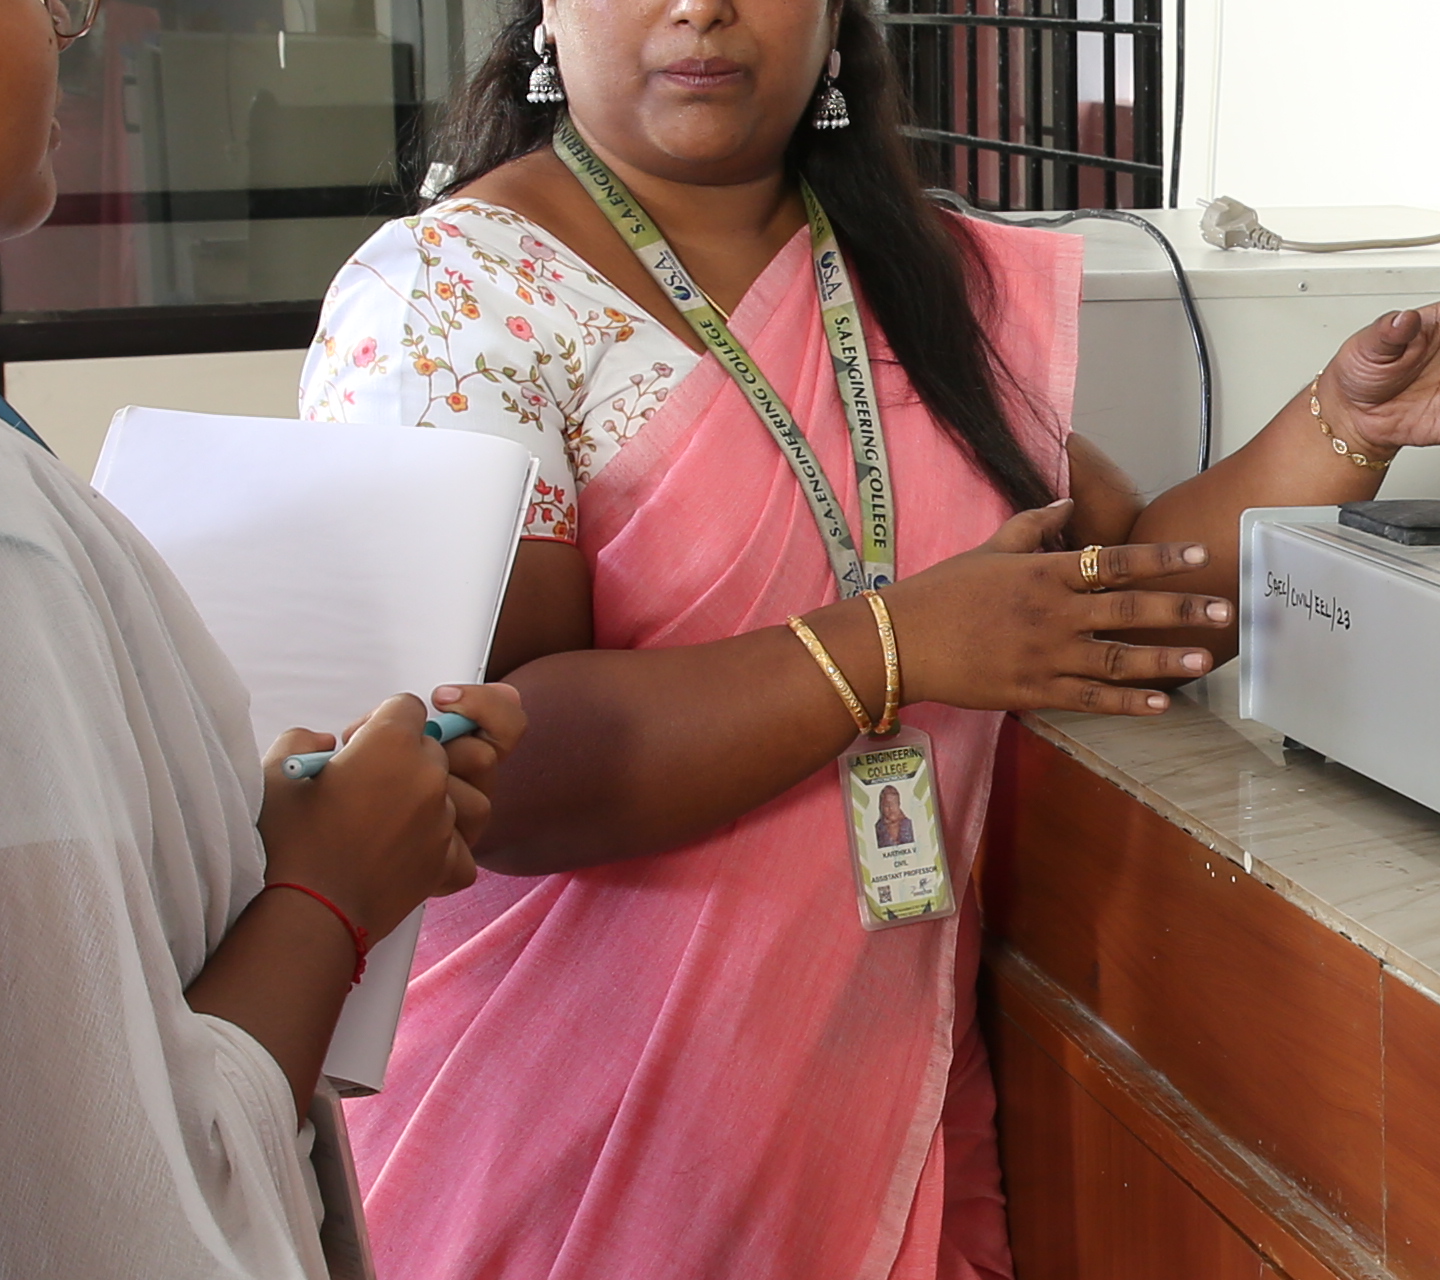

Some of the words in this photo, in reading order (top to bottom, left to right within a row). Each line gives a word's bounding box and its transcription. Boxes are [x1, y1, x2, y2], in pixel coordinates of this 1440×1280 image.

[654, 251, 683, 286] S.A.
[824, 265, 842, 300] S.A.
[700, 319, 756, 384] COLLEGE
[834, 316, 879, 461] S.A.ENGINEERING
[868, 466, 887, 548] COLLEGE
[753, 388, 842, 538] S.A.ENGINEERING
[866, 761, 909, 778] COLLEGE
[870, 871, 902, 883] ASSISTANT
[902, 865, 938, 877] PROFESSOR
